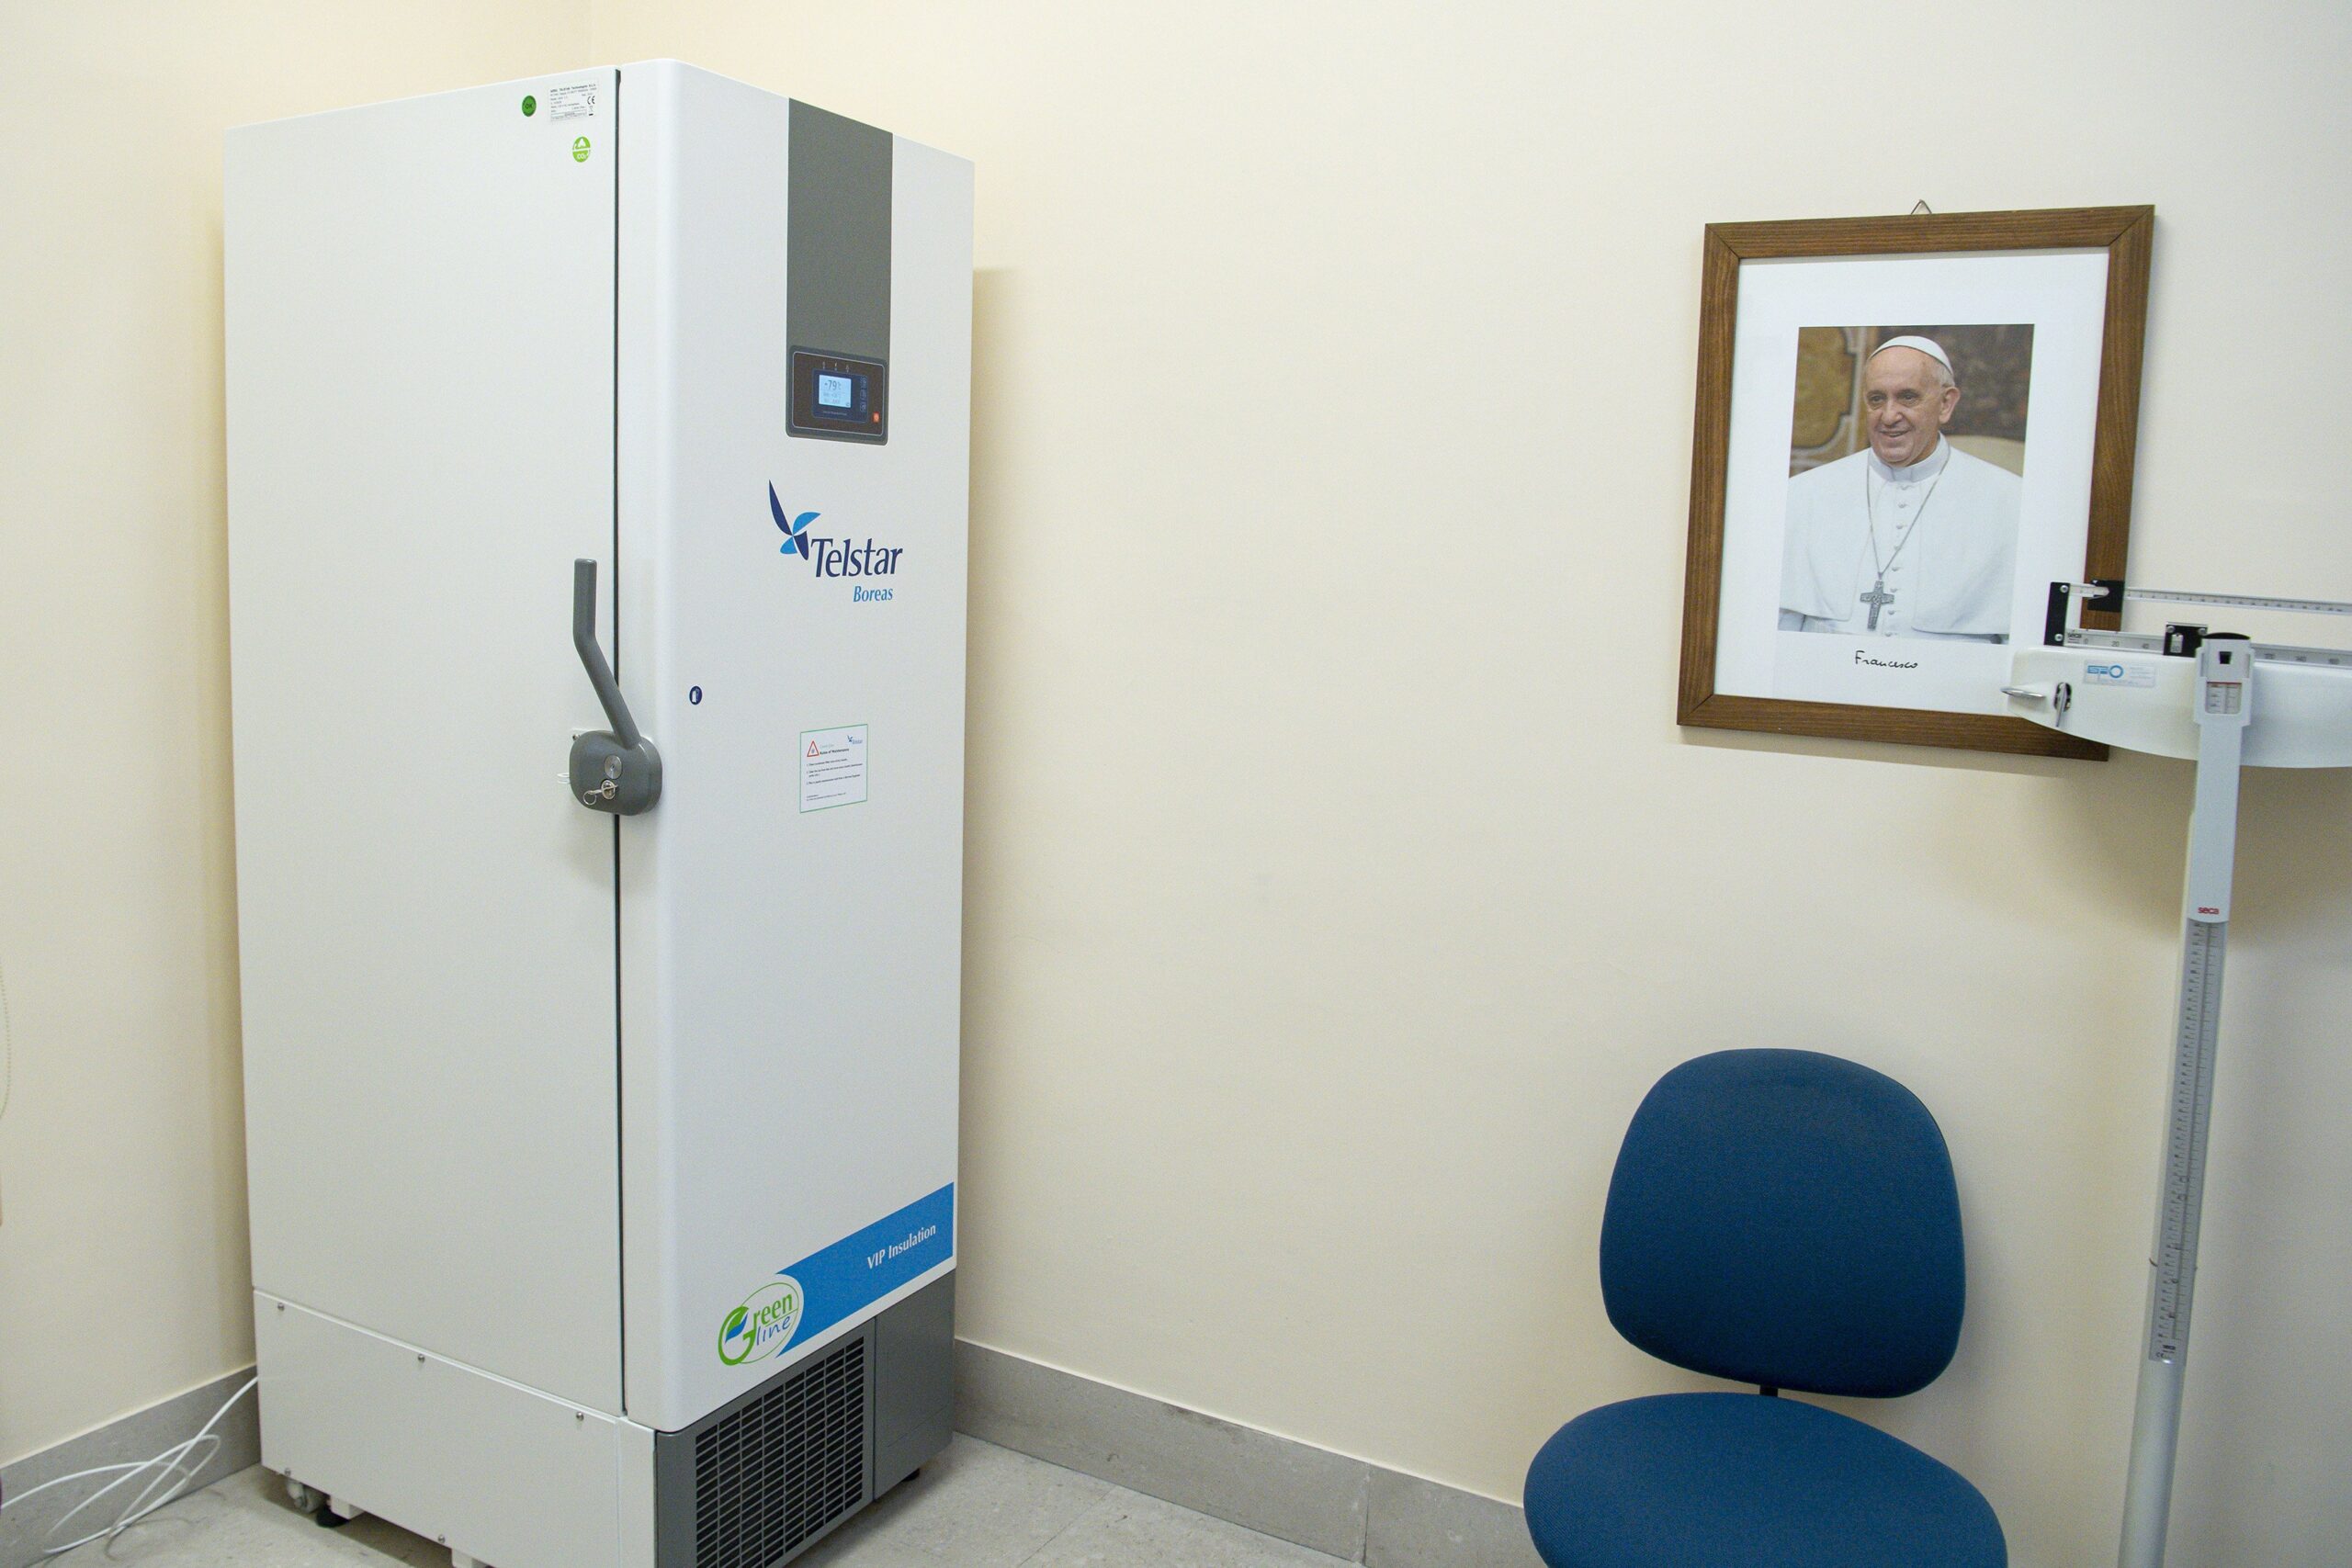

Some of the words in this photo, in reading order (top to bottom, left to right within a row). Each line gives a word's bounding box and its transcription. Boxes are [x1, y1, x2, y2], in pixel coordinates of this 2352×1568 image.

[810, 537, 903, 578] Telstar
[853, 585, 894, 603] Boreas
[1855, 649, 1918, 669] Francesco
[866, 1248, 886, 1269] VIP
[888, 1224, 936, 1259] Insulation
[718, 1293, 793, 1366] Green
